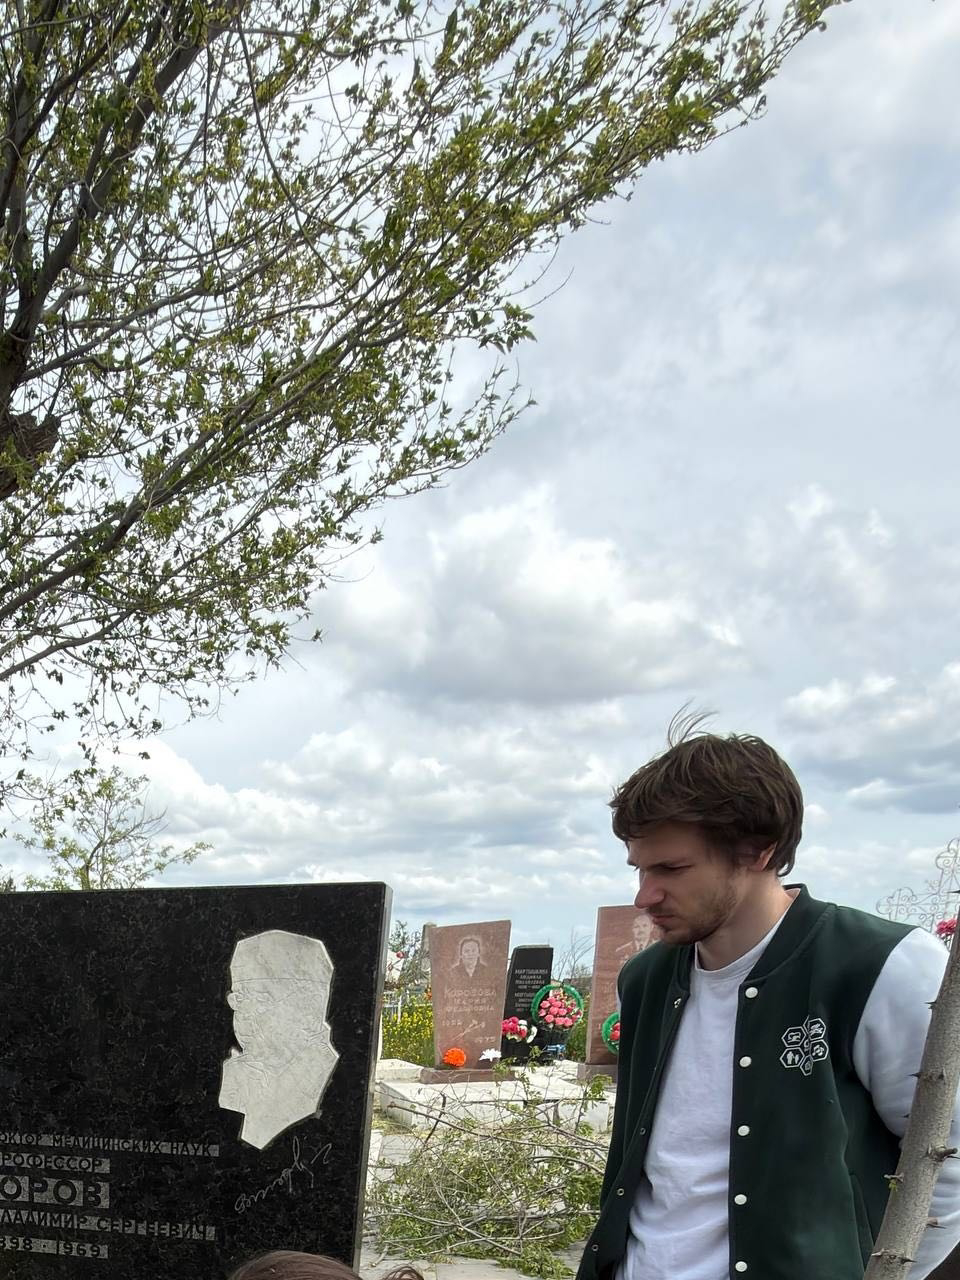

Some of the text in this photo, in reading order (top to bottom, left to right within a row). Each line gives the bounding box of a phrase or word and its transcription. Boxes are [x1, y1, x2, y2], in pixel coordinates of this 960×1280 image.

[52, 1134, 160, 1154] МЕДИЦИНСКИХ
[170, 1142, 212, 1157] НАУК
[97, 1215, 207, 1240] СЕРГЕЕВИЧ
[56, 1239, 101, 1258] 1969
